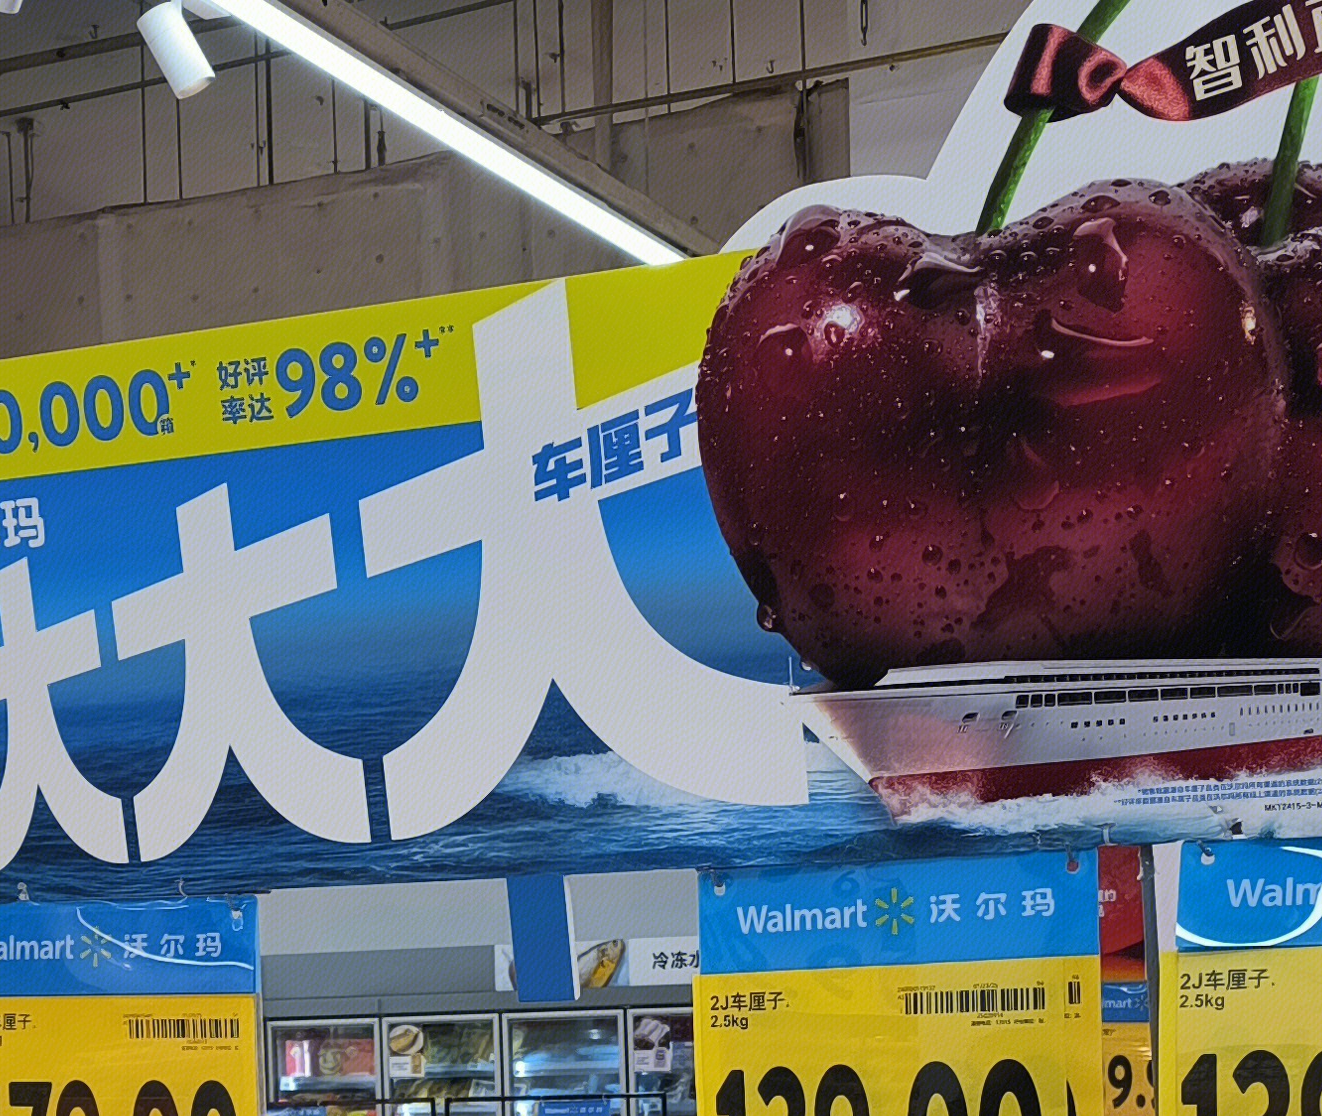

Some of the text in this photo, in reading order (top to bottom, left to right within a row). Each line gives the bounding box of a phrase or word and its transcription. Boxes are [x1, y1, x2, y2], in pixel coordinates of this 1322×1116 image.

[216, 357, 270, 390] 好评
[221, 391, 274, 424] 率达
[532, 388, 698, 502] 车厘子
[736, 898, 868, 935] Walmart
[928, 887, 1055, 924] 沃尔玛
[123, 932, 223, 959] 沃尔玛
[1179, 993, 1225, 1011] 2.5kg
[710, 1014, 749, 1030] 2.5kg
